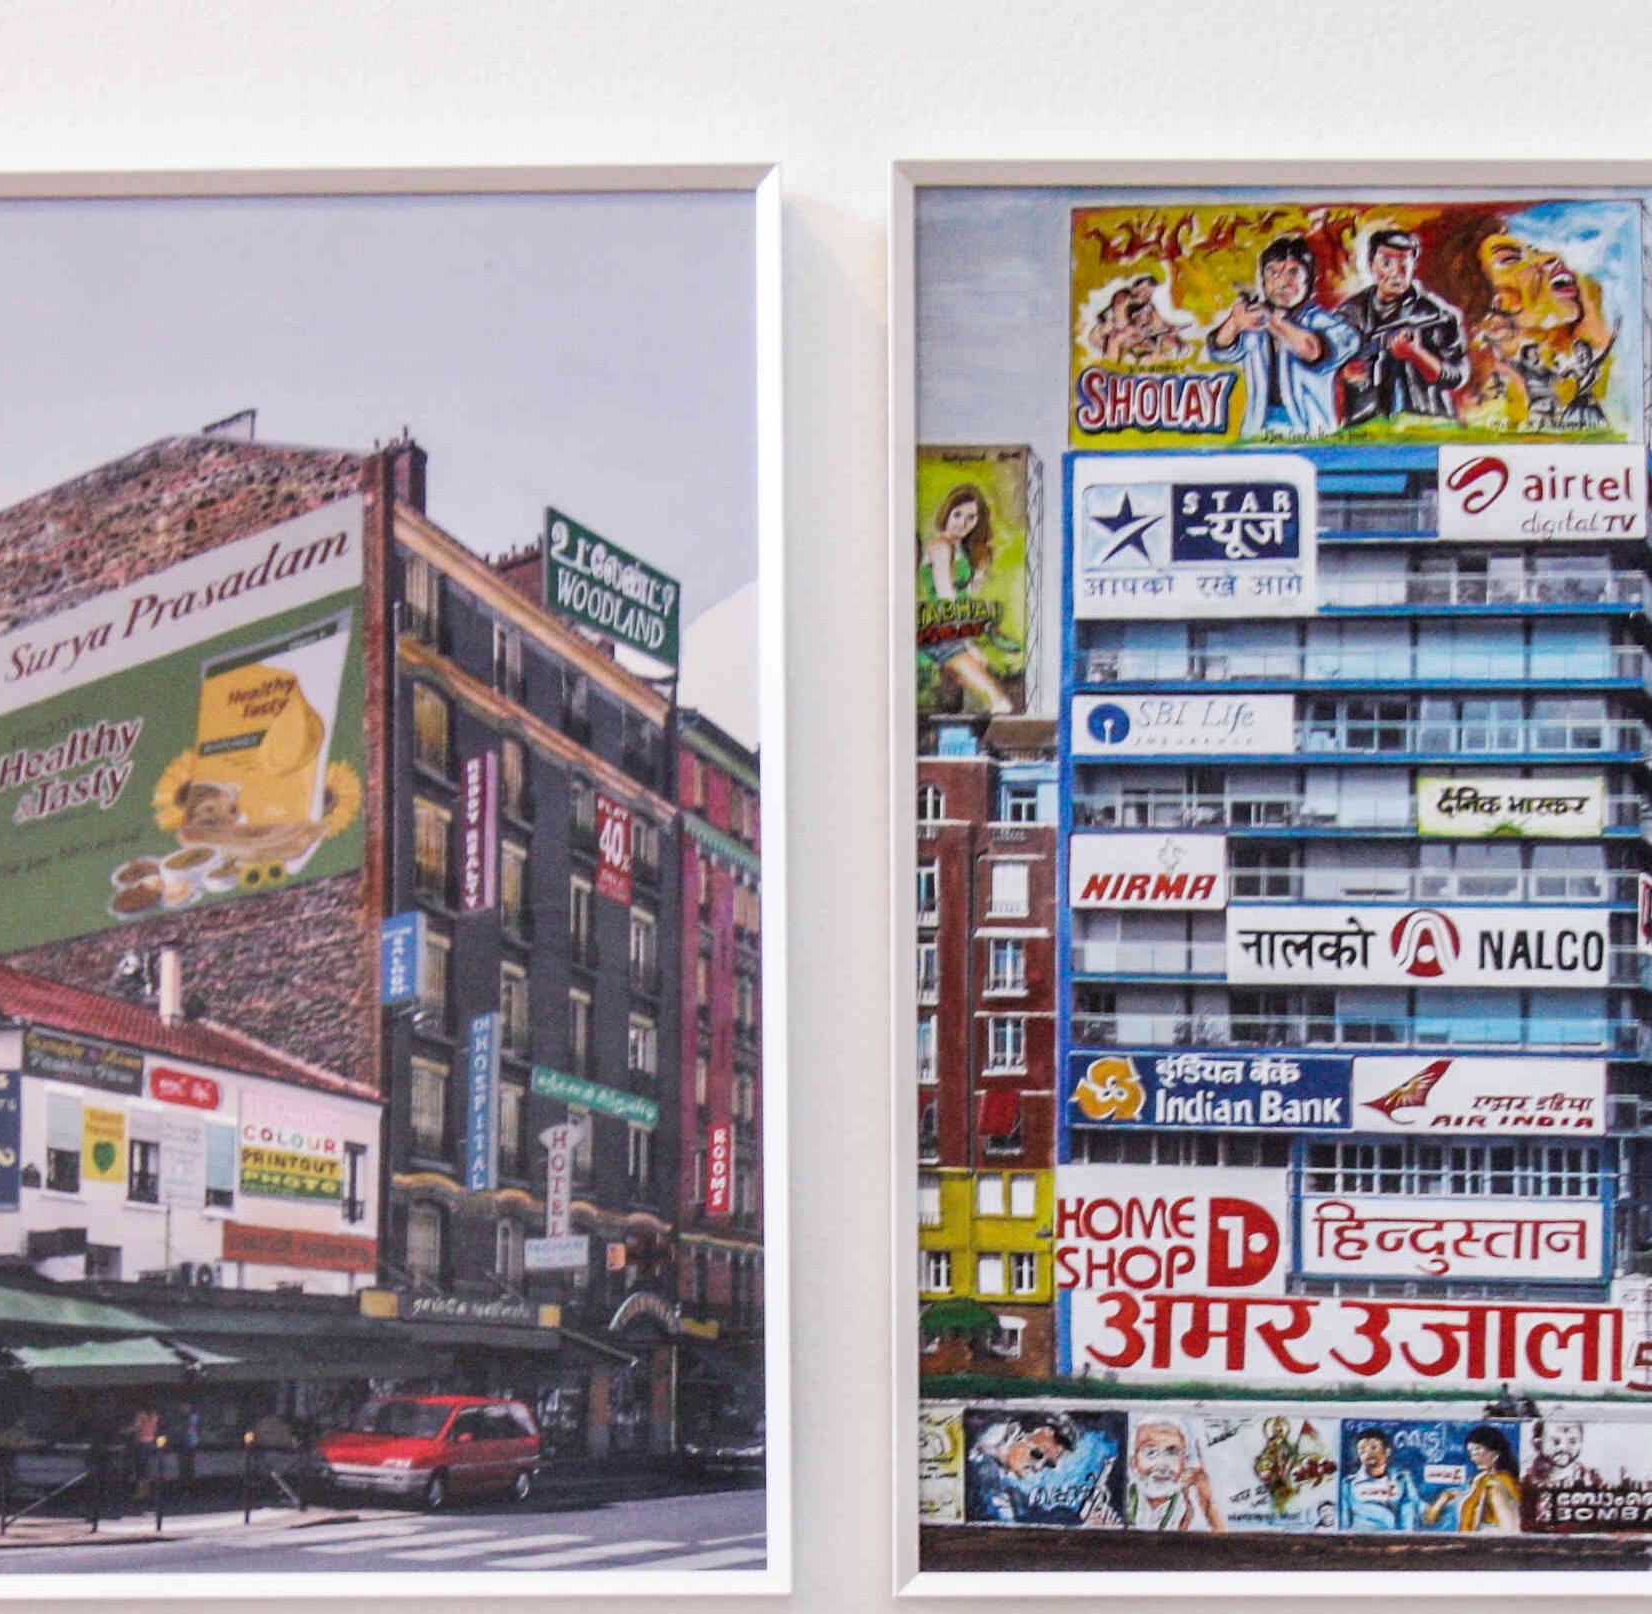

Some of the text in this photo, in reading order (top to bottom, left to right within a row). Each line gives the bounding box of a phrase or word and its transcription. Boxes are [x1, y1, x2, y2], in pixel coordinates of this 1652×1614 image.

[1078, 372, 1231, 431] SHOLAY
[1180, 489, 1292, 514] STAR
[1522, 465, 1633, 504] airtel
[1521, 509, 1637, 537] digital TV
[4, 530, 350, 683] Surya Prasadam
[557, 567, 666, 650] WOODLAND
[1136, 700, 1256, 730] SBI Life
[34, 759, 133, 817] Tasty
[1081, 873, 1217, 902] NIRMA
[1238, 917, 1376, 971] नालको
[1478, 929, 1605, 972] NALCO
[471, 1038, 488, 1191] HOSPITAL
[1154, 1089, 1344, 1127] Indian Bank
[1430, 1114, 1594, 1128] AIR INDIA
[242, 1148, 339, 1175] PRINTOUT
[243, 1125, 336, 1154] COLOUR
[548, 1130, 568, 1238] HOTEL
[709, 1129, 728, 1208] ROOMS
[1056, 1196, 1195, 1242] HOME
[1313, 1201, 1587, 1275] हिन्दुस्तान
[1056, 1246, 1195, 1290] SHOP
[1083, 1289, 1624, 1384] अमर उजाला
